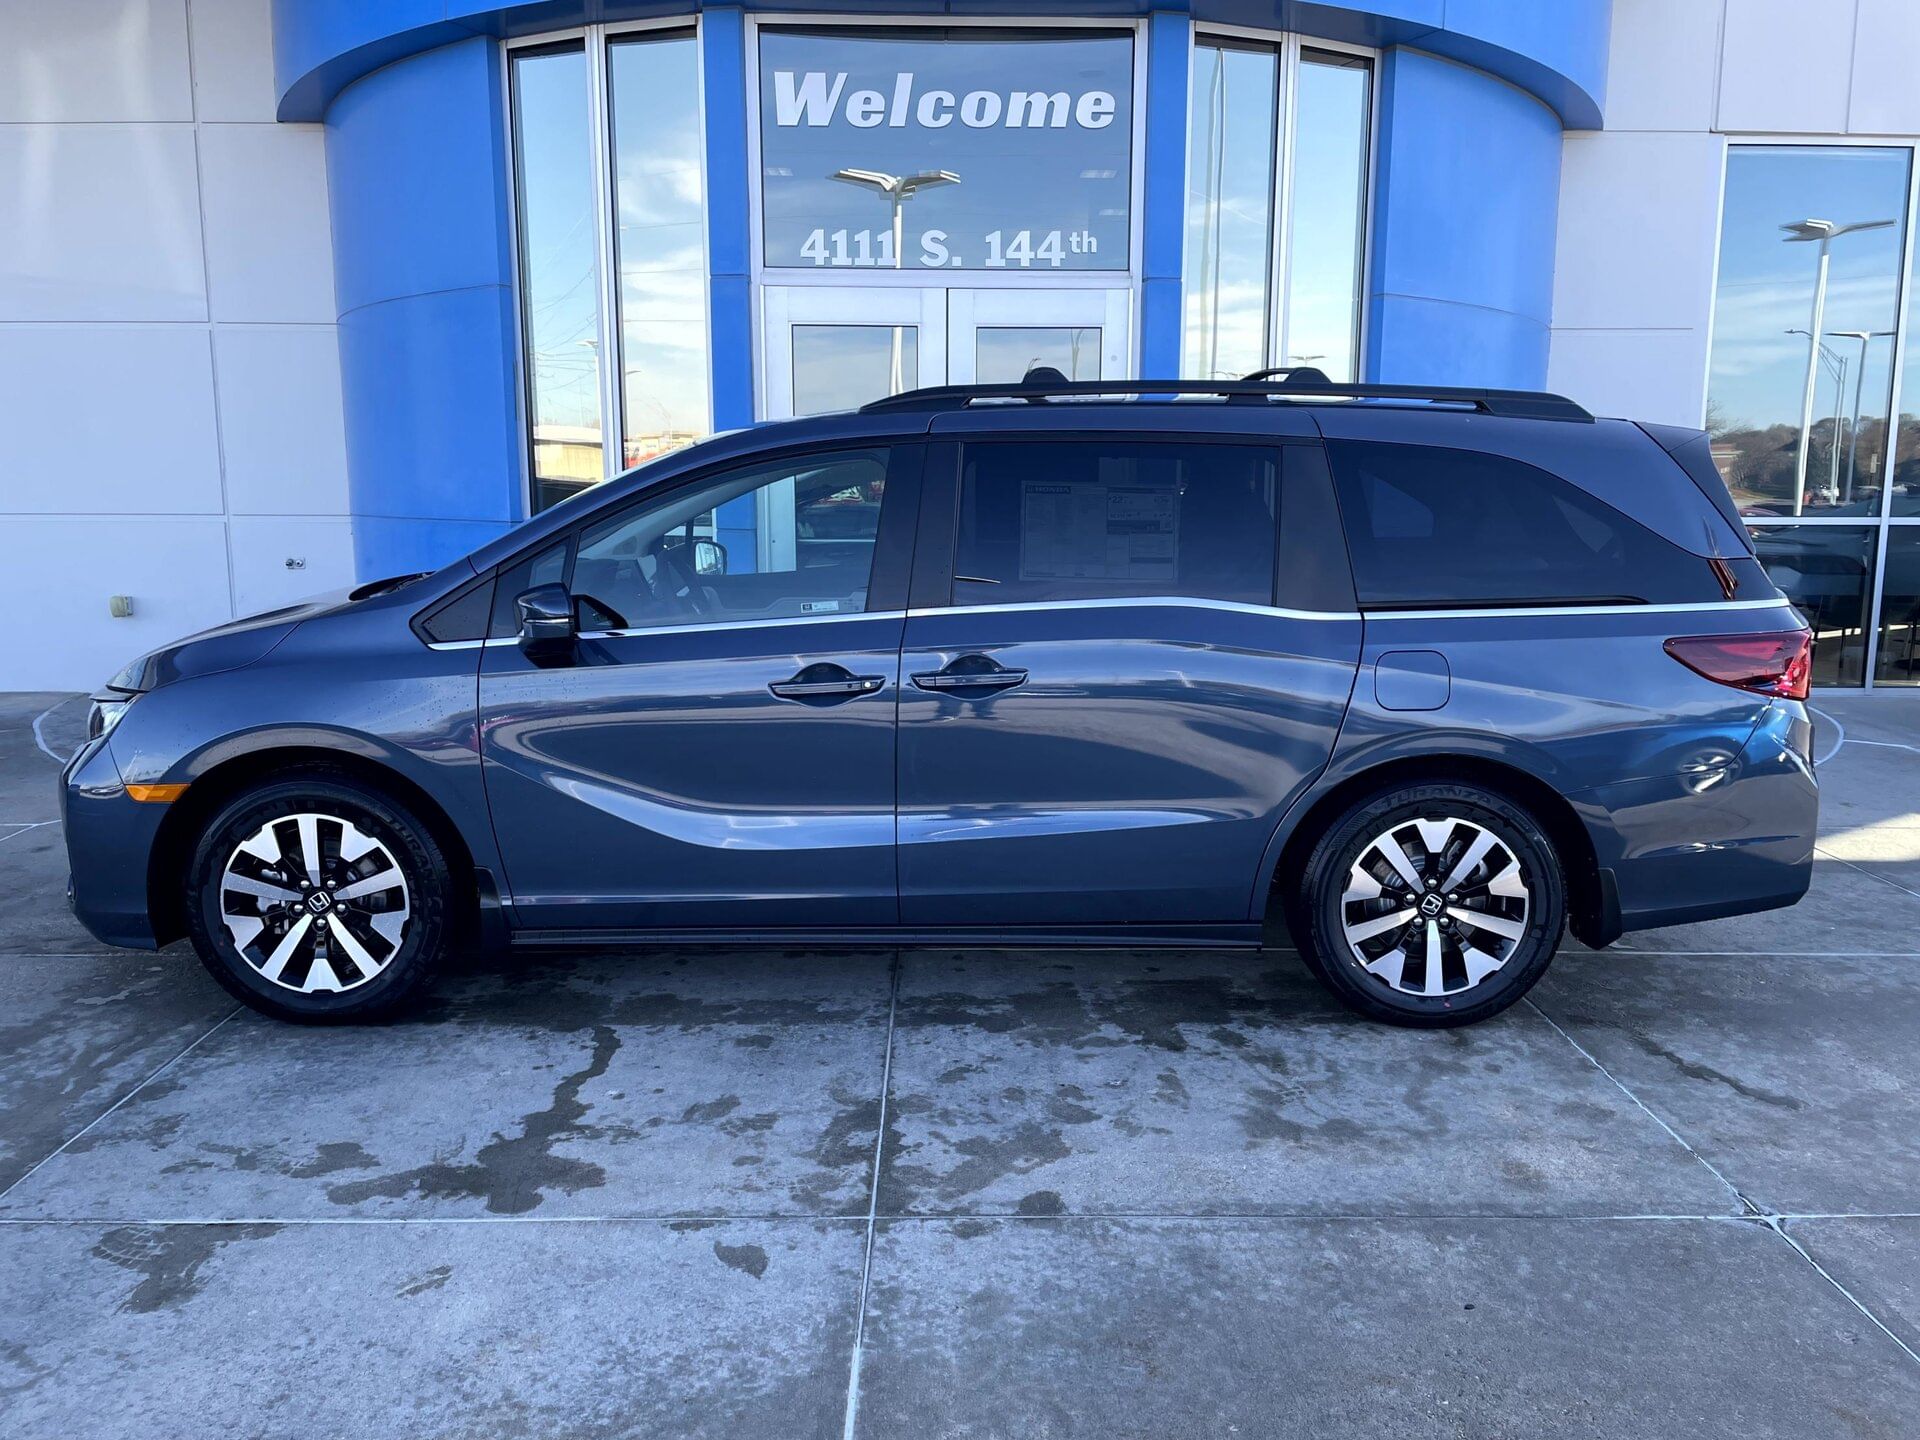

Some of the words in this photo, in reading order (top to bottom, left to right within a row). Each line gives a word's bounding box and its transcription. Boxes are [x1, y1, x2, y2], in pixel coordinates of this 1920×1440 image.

[773, 71, 1116, 128] Welcome
[800, 228, 897, 266] 4111
[920, 229, 962, 267] S.
[985, 230, 1097, 267] 144th
